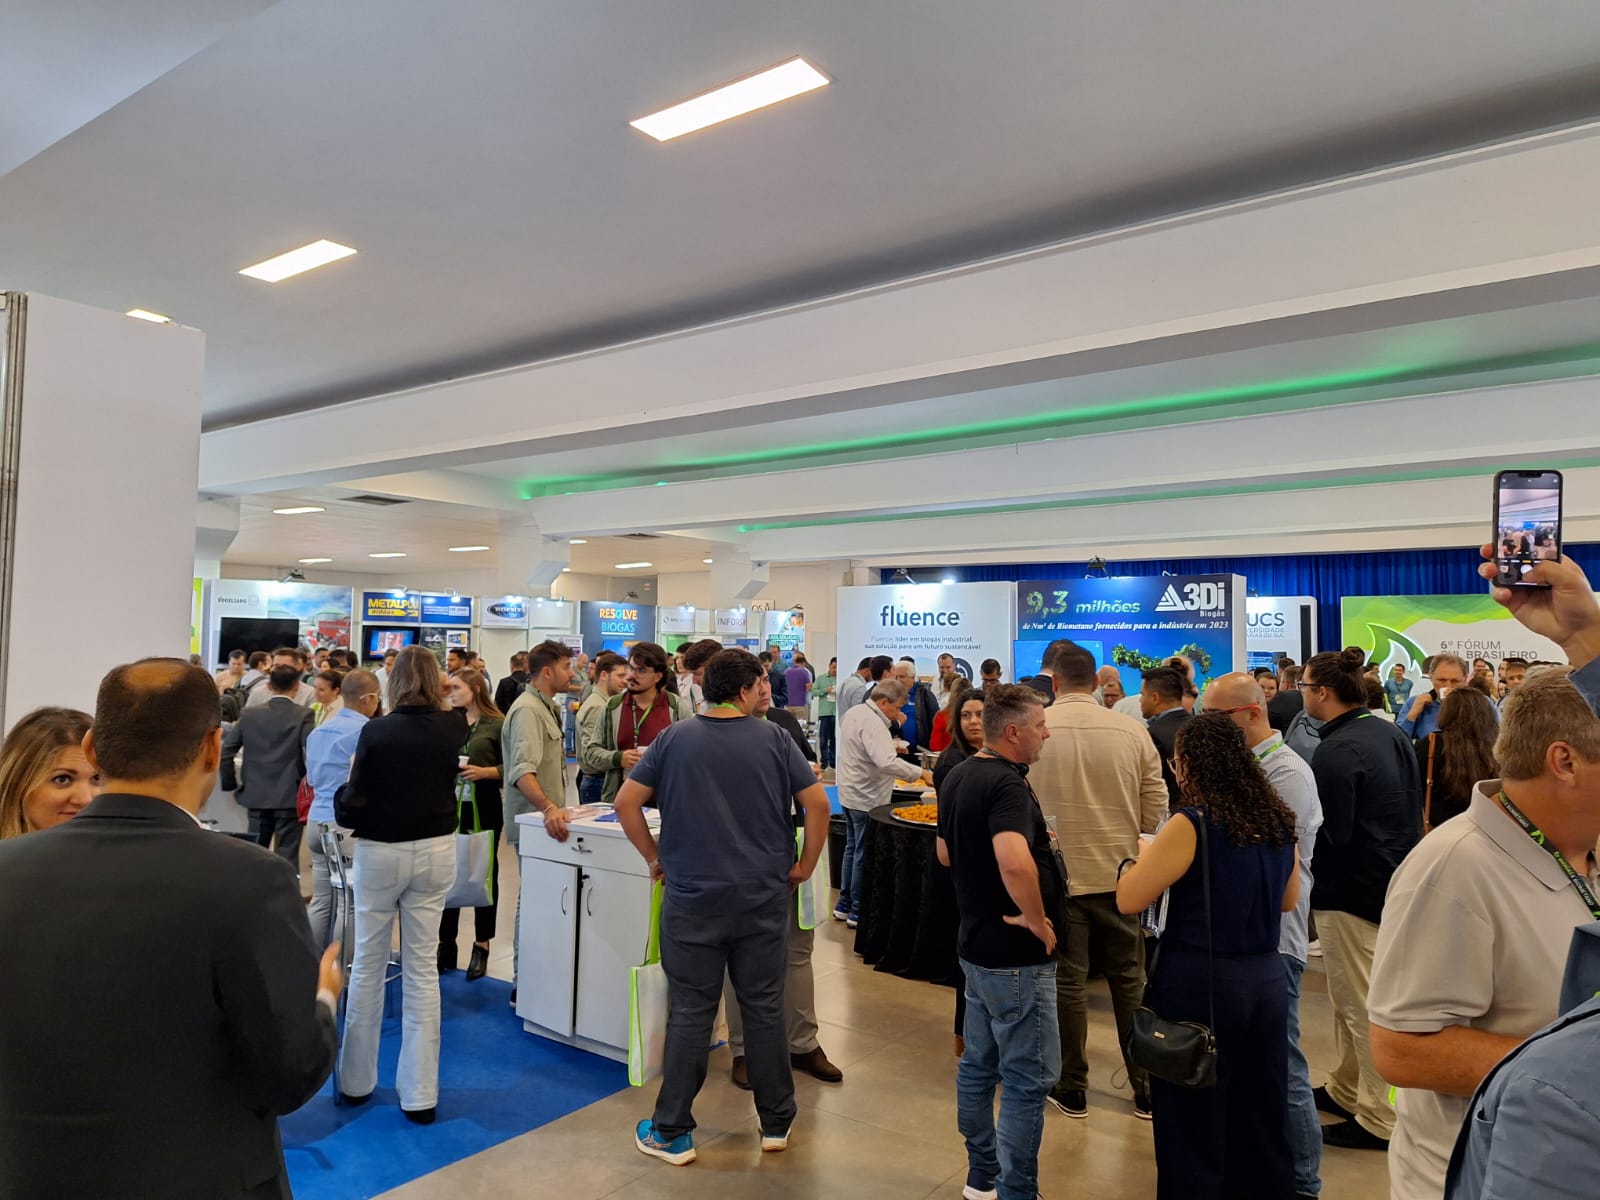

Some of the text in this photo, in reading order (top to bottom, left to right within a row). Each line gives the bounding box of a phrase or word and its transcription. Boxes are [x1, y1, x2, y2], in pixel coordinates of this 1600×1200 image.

[1183, 582, 1225, 611] 3Di
[1025, 590, 1140, 619] 9,3 milhões
[599, 608, 638, 620] RESOLVE
[880, 605, 960, 627] fluence
[1200, 610, 1225, 618] Biogás
[1247, 612, 1285, 626] UCS
[601, 622, 635, 632] BIOGAS
[1022, 622, 1031, 630] de
[1047, 622, 1056, 630] de
[1056, 622, 1094, 630] Biometano
[1093, 622, 1132, 631] fornecidos
[1132, 623, 1152, 631] para
[1158, 621, 1194, 629] indústria
[1208, 621, 1229, 629] 2023
[898, 643, 912, 651] para
[924, 642, 944, 650] futuro
[944, 642, 981, 650] sustentável
[1457, 638, 1501, 650] FÓRUM
[1466, 650, 1538, 660] BRASILEIRO
